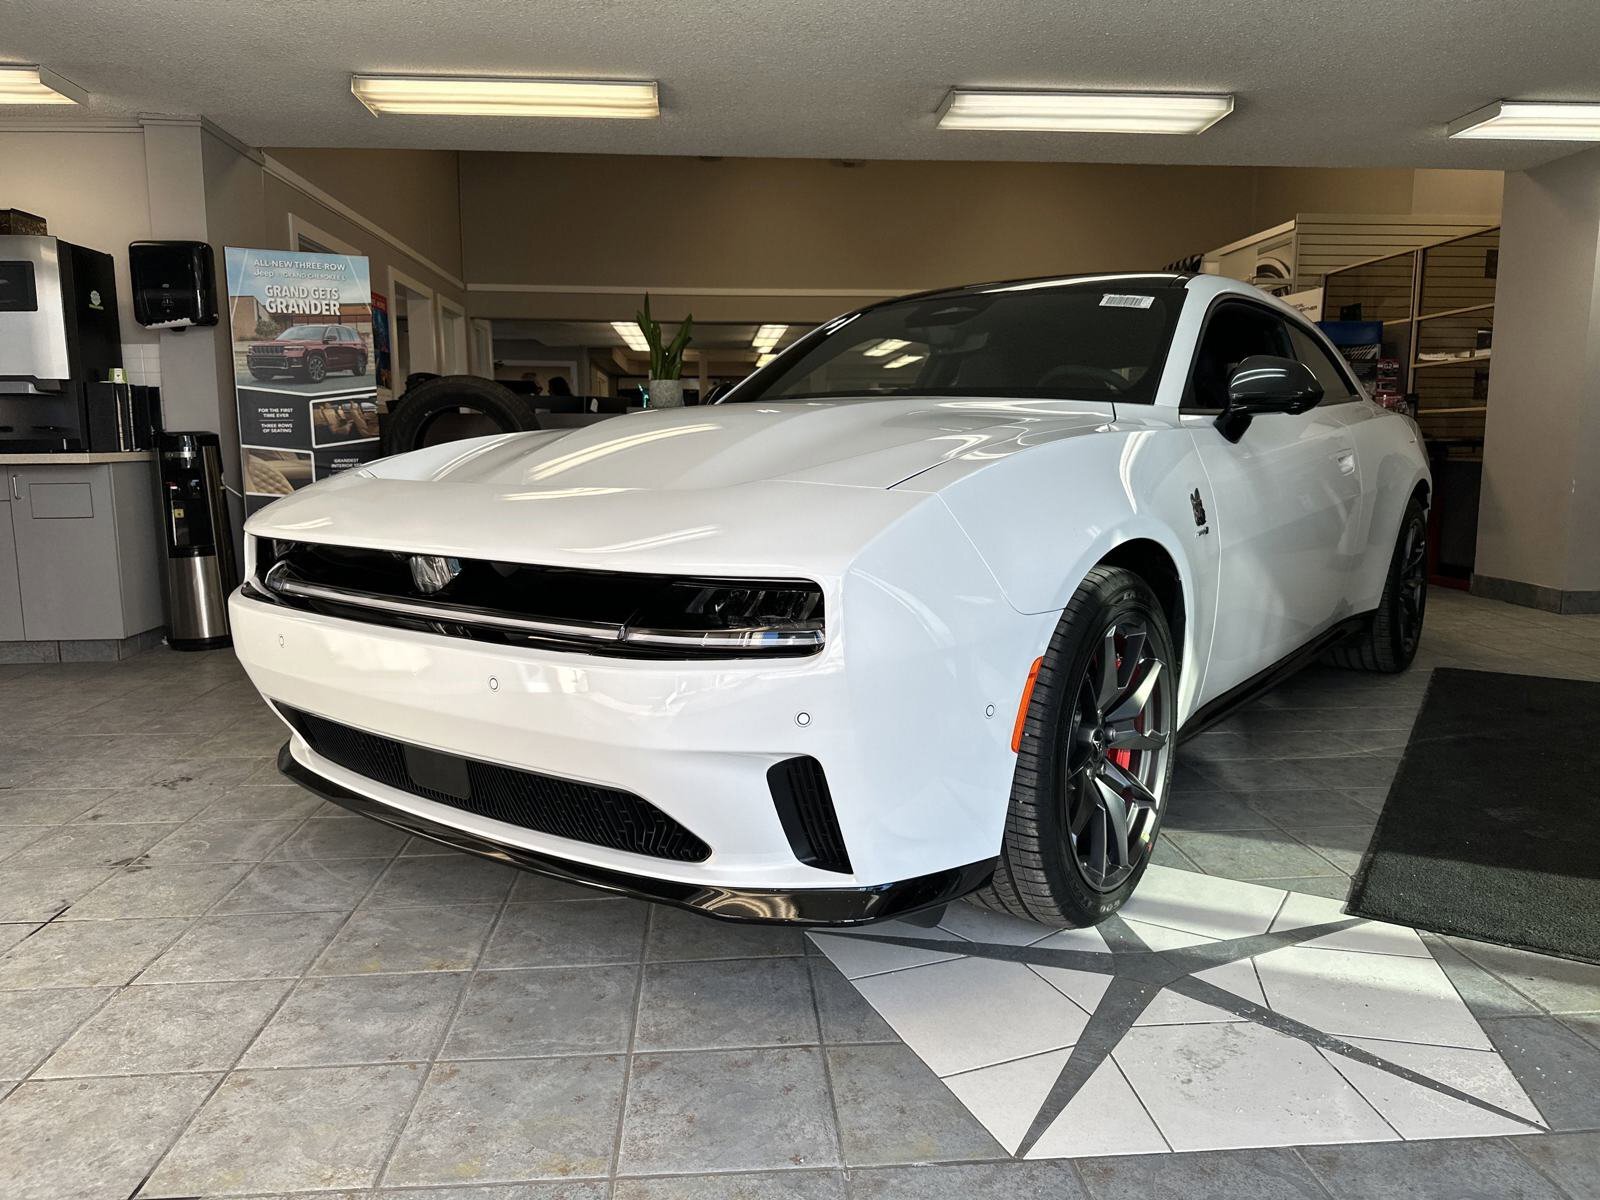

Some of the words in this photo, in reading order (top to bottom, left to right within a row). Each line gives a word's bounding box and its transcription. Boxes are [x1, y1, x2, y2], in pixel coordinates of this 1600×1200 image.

[254, 269, 274, 278] Jeep
[265, 285, 308, 298] GRAND
[311, 287, 339, 299] GETS
[265, 298, 341, 316] GRANDER
